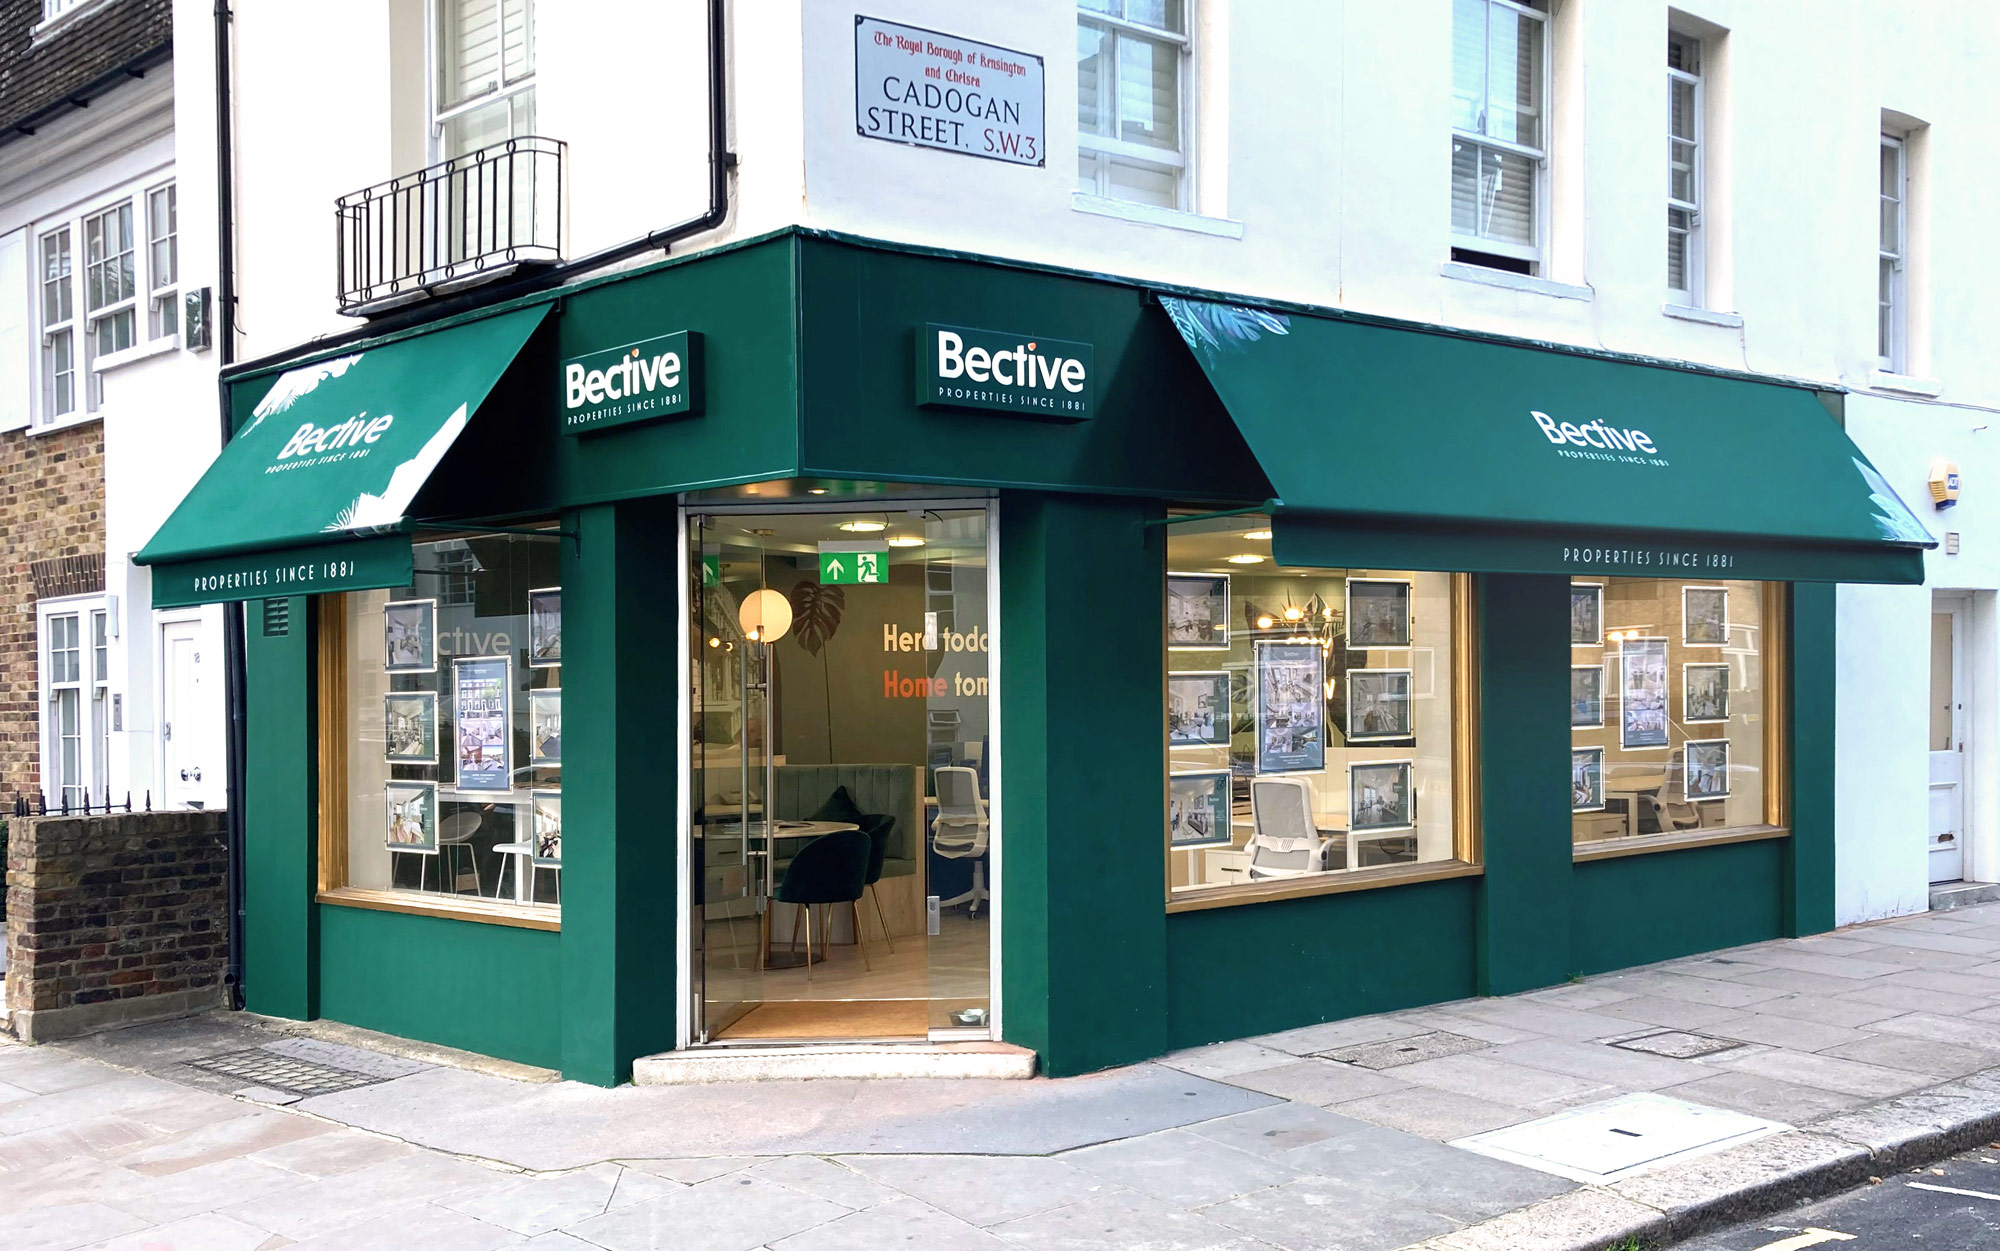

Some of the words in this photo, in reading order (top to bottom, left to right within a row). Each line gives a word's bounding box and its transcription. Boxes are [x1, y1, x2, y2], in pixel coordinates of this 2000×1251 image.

[874, 31, 893, 47] The
[896, 35, 923, 56] Royal
[927, 42, 963, 64] Borough
[967, 51, 976, 65] of
[980, 53, 1026, 77] Kensington
[925, 66, 941, 79] and
[945, 69, 981, 88] Chelsea
[883, 76, 1020, 125] CADOGAN
[868, 106, 969, 148] STREET,
[983, 128, 1037, 160] S.W.3
[938, 330, 1086, 393] Bective
[566, 348, 681, 409] Bective
[567, 406, 622, 426] PROPERTIES
[627, 399, 655, 414] SINCE
[661, 393, 682, 407] 1881
[939, 387, 1013, 404] PROPERTIES
[1020, 396, 1054, 408] SINCE
[1062, 401, 1085, 411] 1881
[276, 411, 394, 460] Bective
[1530, 410, 1658, 454] Bective
[265, 458, 317, 475] PROPERTIES
[318, 452, 347, 465] SINCE
[348, 448, 371, 460] 1881
[1557, 449, 1616, 462] PROPERTIES
[1618, 455, 1647, 465] SINCE
[1649, 458, 1670, 467] 1881
[1563, 547, 1650, 565] PROPERTIES
[1659, 552, 1698, 567] SINCE
[1706, 554, 1733, 568] 1881
[194, 569, 268, 592] PROPERTIES
[275, 564, 314, 584] SINCE
[323, 560, 354, 579] 1881
[437, 624, 511, 656] ctive
[883, 623, 926, 652] Her
[884, 670, 948, 698] Home
